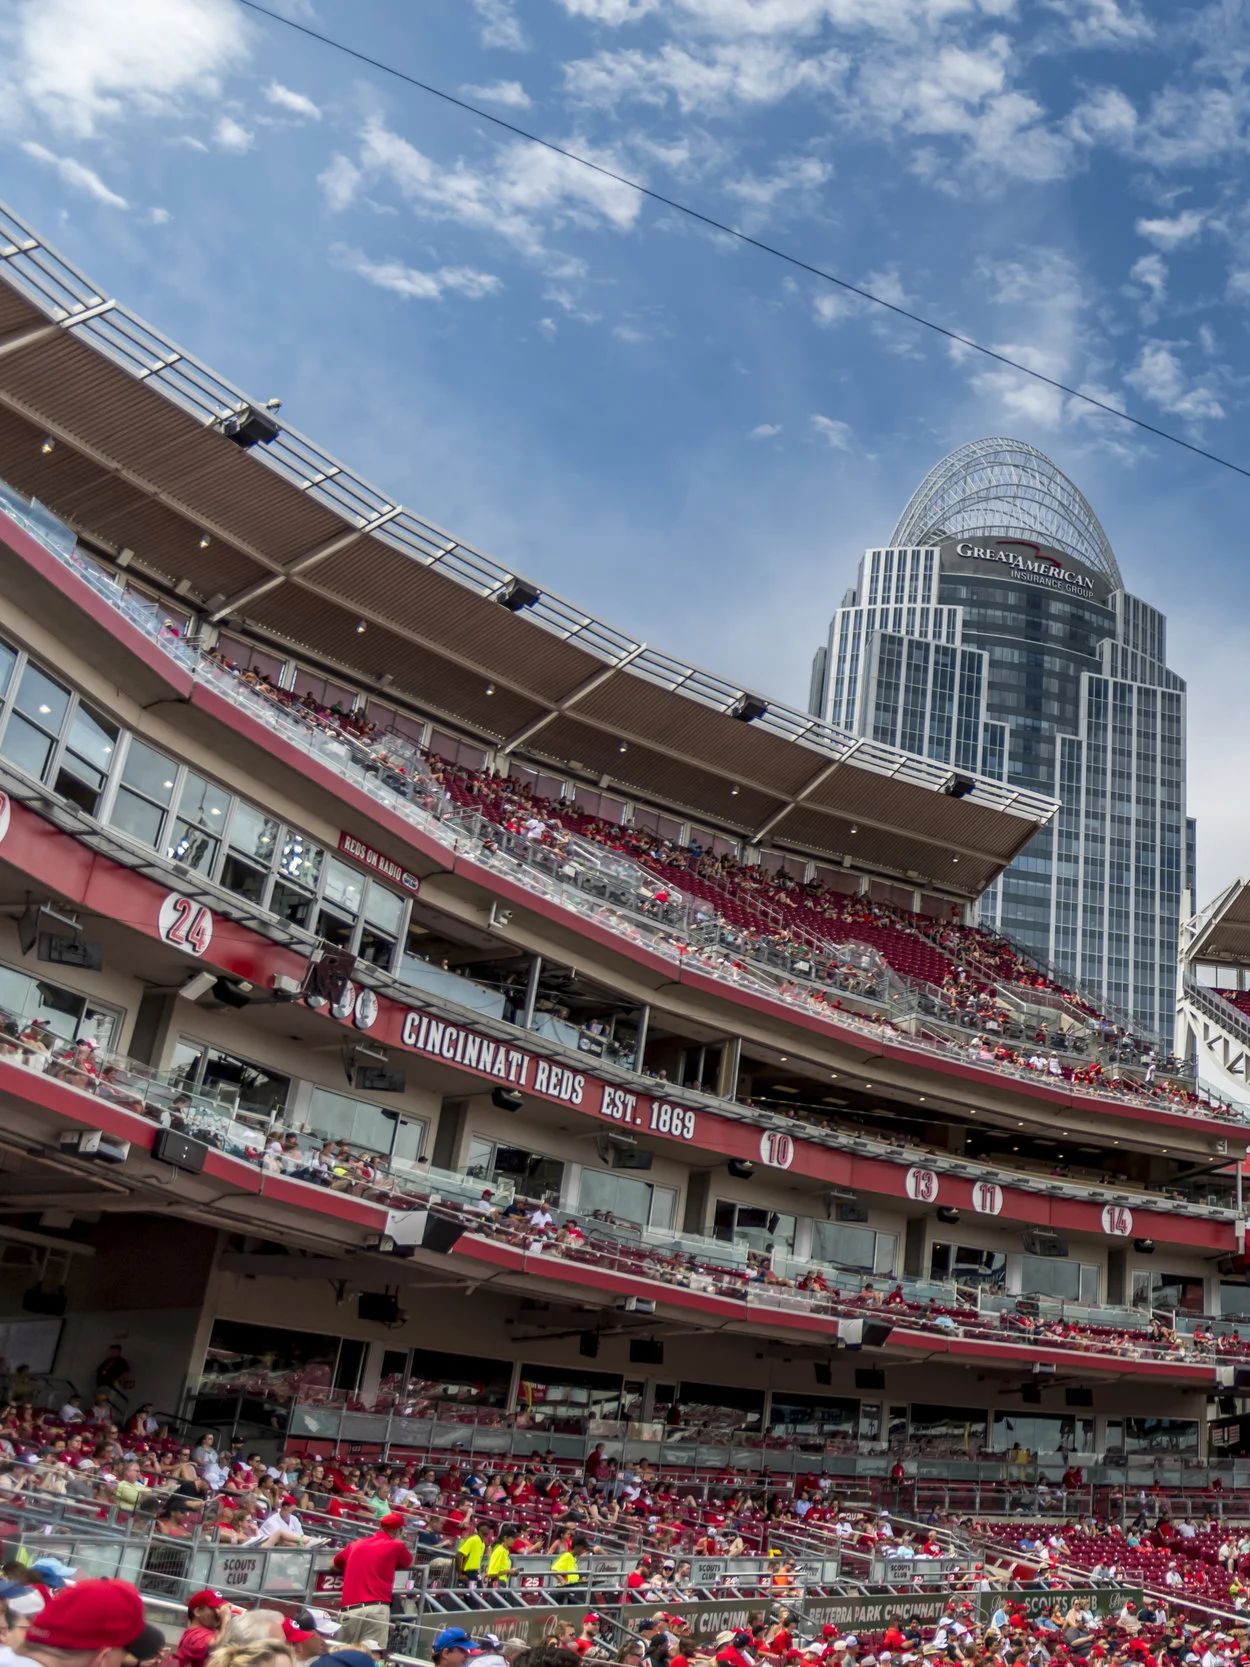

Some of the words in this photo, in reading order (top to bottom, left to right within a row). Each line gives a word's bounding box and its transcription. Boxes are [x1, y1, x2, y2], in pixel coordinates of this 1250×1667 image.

[1011, 570, 1062, 590] INSURANCE
[1066, 584, 1094, 598] GROUP
[344, 836, 366, 859] REDS
[366, 850, 379, 866] ON
[378, 857, 402, 880] RADIO
[167, 897, 209, 953] 24
[402, 1011, 529, 1086] CINCINNATI
[534, 1060, 584, 1105] REDS
[601, 1085, 641, 1125] EST.
[650, 1102, 696, 1140] 1869
[768, 1133, 789, 1165] 10
[914, 1169, 933, 1200] 13
[980, 1184, 996, 1213] 11
[1107, 1207, 1128, 1234] 14
[223, 1559, 256, 1572] SCOUTS
[226, 1573, 249, 1585] CLUB
[699, 1564, 720, 1572] SCOUTS
[323, 1576, 344, 1589] 25
[525, 1577, 539, 1587] 25
[809, 1606, 852, 1624] BELTERRA
[854, 1604, 882, 1621] PARK
[885, 1602, 945, 1620] CINCINNATI
